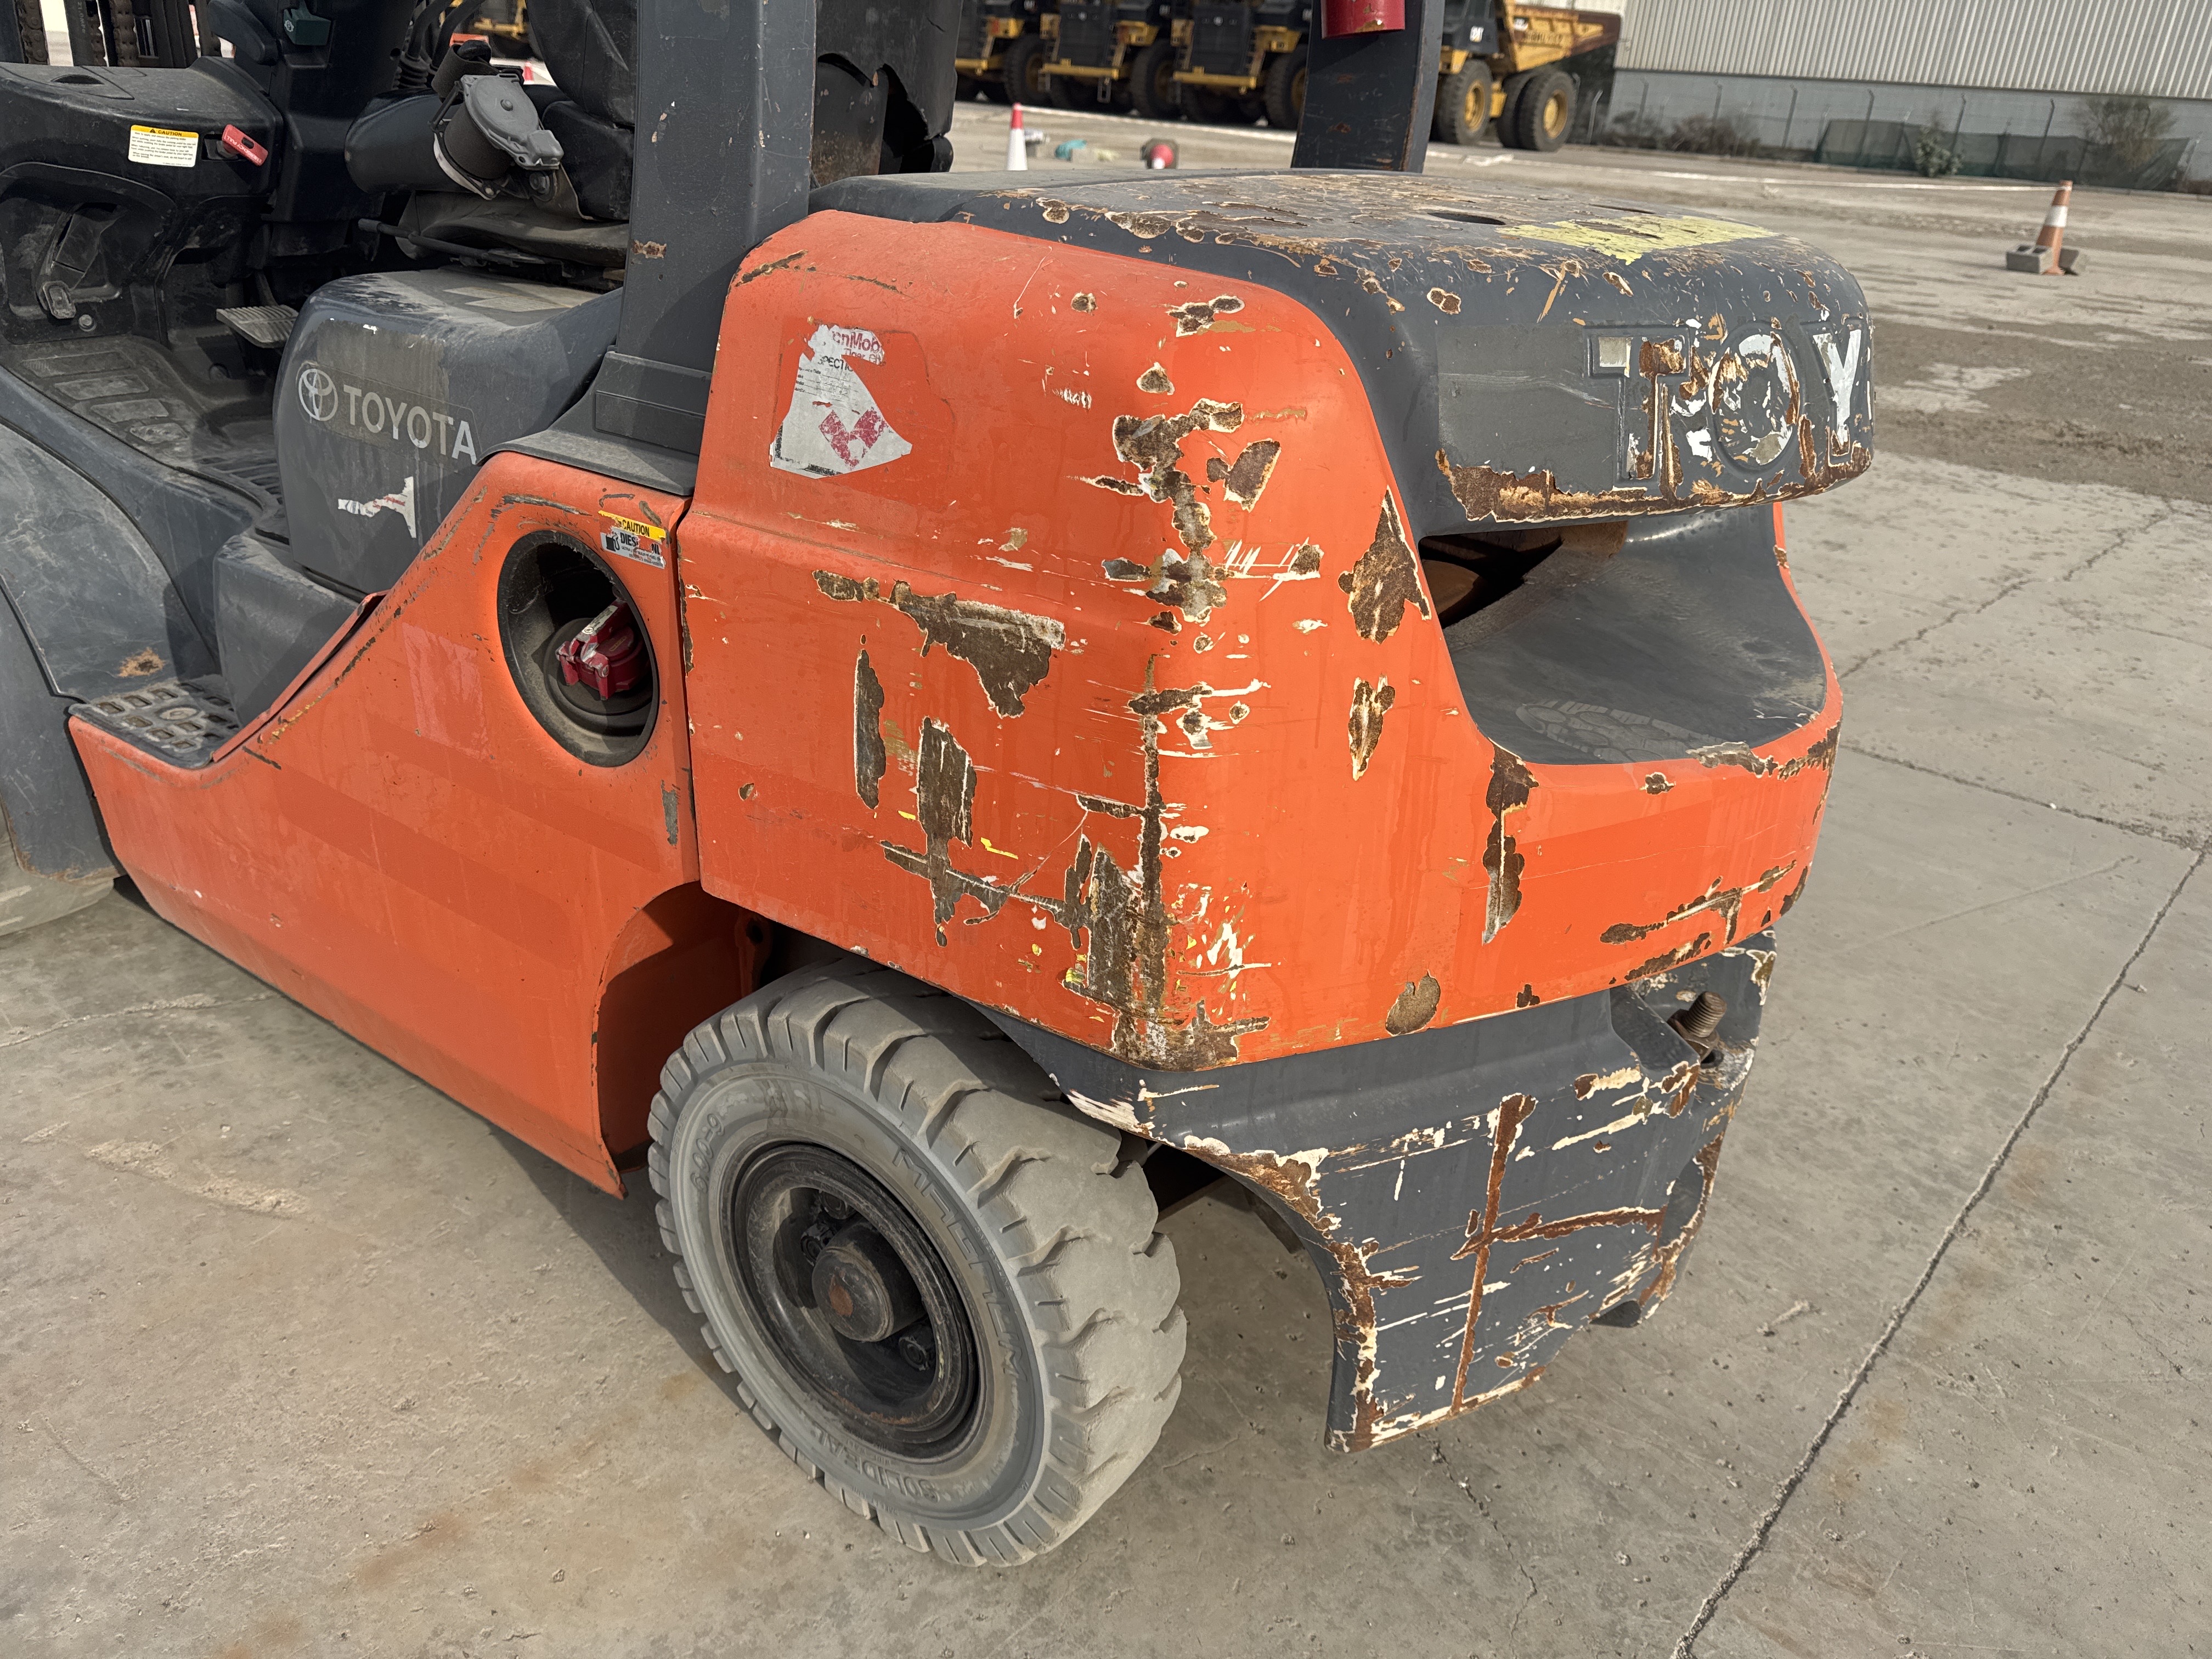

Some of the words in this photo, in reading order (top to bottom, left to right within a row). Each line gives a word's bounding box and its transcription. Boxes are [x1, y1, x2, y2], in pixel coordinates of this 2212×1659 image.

[226, 136, 237, 145] PULL
[343, 384, 477, 465] TOYOTA
[622, 519, 650, 538] CAUTION
[891, 1146, 1029, 1383] MAGNUM
[811, 1422, 941, 1503] SOLIDEAL
